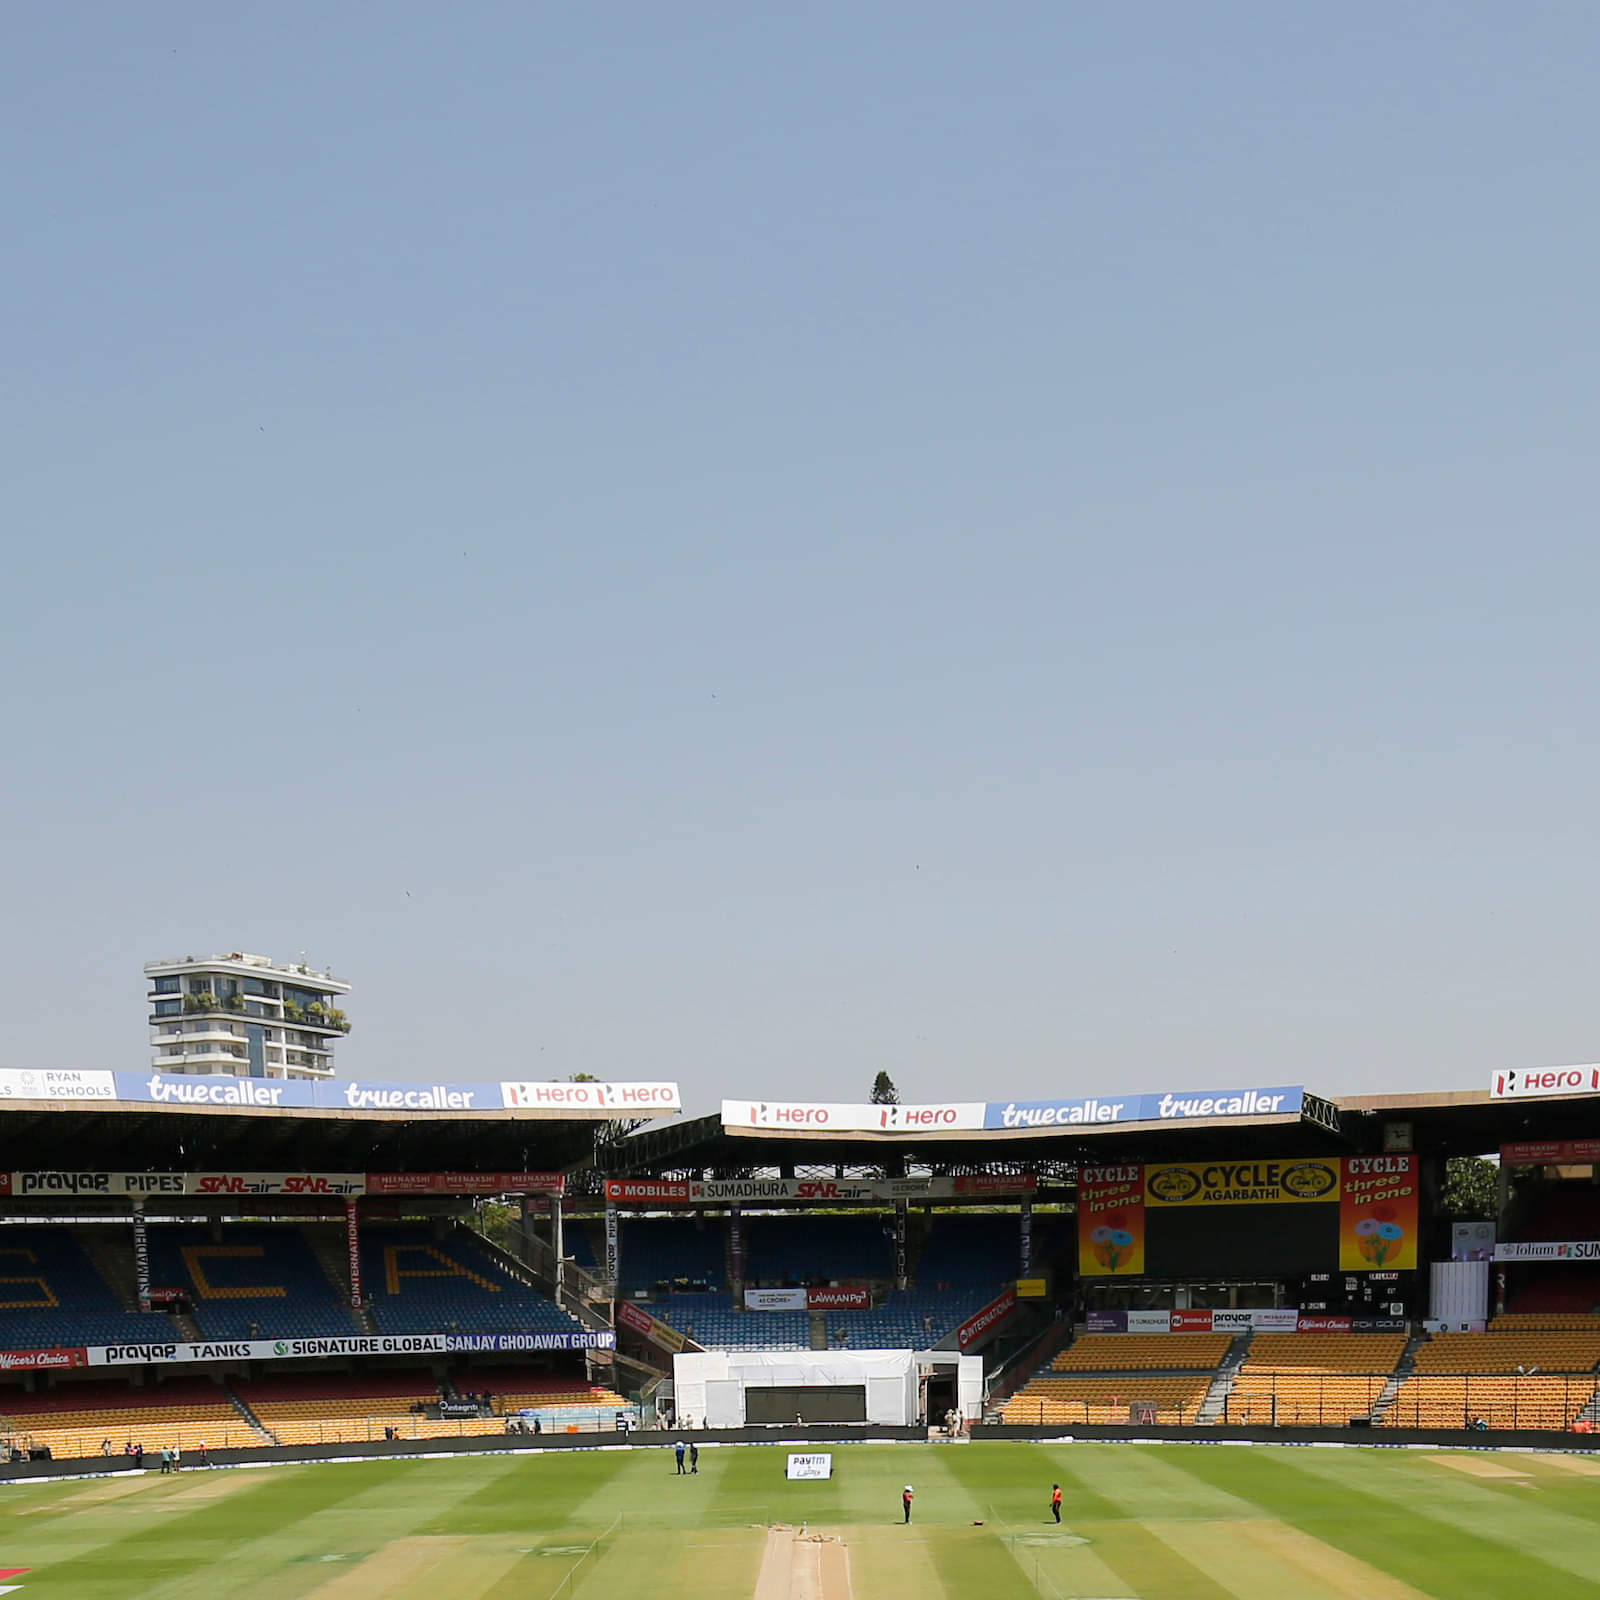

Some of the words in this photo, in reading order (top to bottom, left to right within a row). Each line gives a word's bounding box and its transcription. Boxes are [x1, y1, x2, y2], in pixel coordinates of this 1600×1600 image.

[46, 1072, 81, 1082] RYAN
[1524, 1070, 1583, 1089] Hero
[49, 1085, 111, 1097] SCHOOLS
[146, 1075, 283, 1106] truecaller
[344, 1082, 473, 1109] truecaller
[536, 1087, 589, 1102] Hero
[623, 1086, 674, 1102] Hero
[1157, 1091, 1285, 1119] truecaller
[775, 1107, 830, 1124] Hero
[905, 1106, 957, 1125] Hero
[1001, 1101, 1124, 1129] truecaller
[1347, 1156, 1410, 1175] CYCLE
[21, 1171, 110, 1193] prayag
[125, 1175, 184, 1192] PIPES
[196, 1175, 249, 1193] STAR
[1083, 1166, 1139, 1184] CYCLE
[1202, 1164, 1281, 1189] CYCLE
[1343, 1173, 1401, 1193] three
[281, 1176, 333, 1193] STAR
[625, 1184, 686, 1197] MOBILES
[707, 1182, 789, 1199] SUMADHURA
[794, 1182, 843, 1198] STAR
[1081, 1183, 1132, 1201] three
[1089, 1197, 1104, 1212] in
[1105, 1194, 1141, 1210] one
[1202, 1188, 1280, 1201] AGARBATHI
[1354, 1191, 1369, 1206] in
[1369, 1185, 1413, 1204] one
[292, 1338, 377, 1354] SIGNATURE
[382, 1336, 443, 1352] GLOBAL
[446, 1334, 497, 1352] SANJAY
[499, 1333, 569, 1351] GHODAWAT
[570, 1332, 615, 1350] GROUP
[35, 1351, 70, 1366] Choice
[105, 1344, 176, 1362] prayag
[189, 1344, 251, 1358] TANKS
[793, 1455, 826, 1465] paytm
